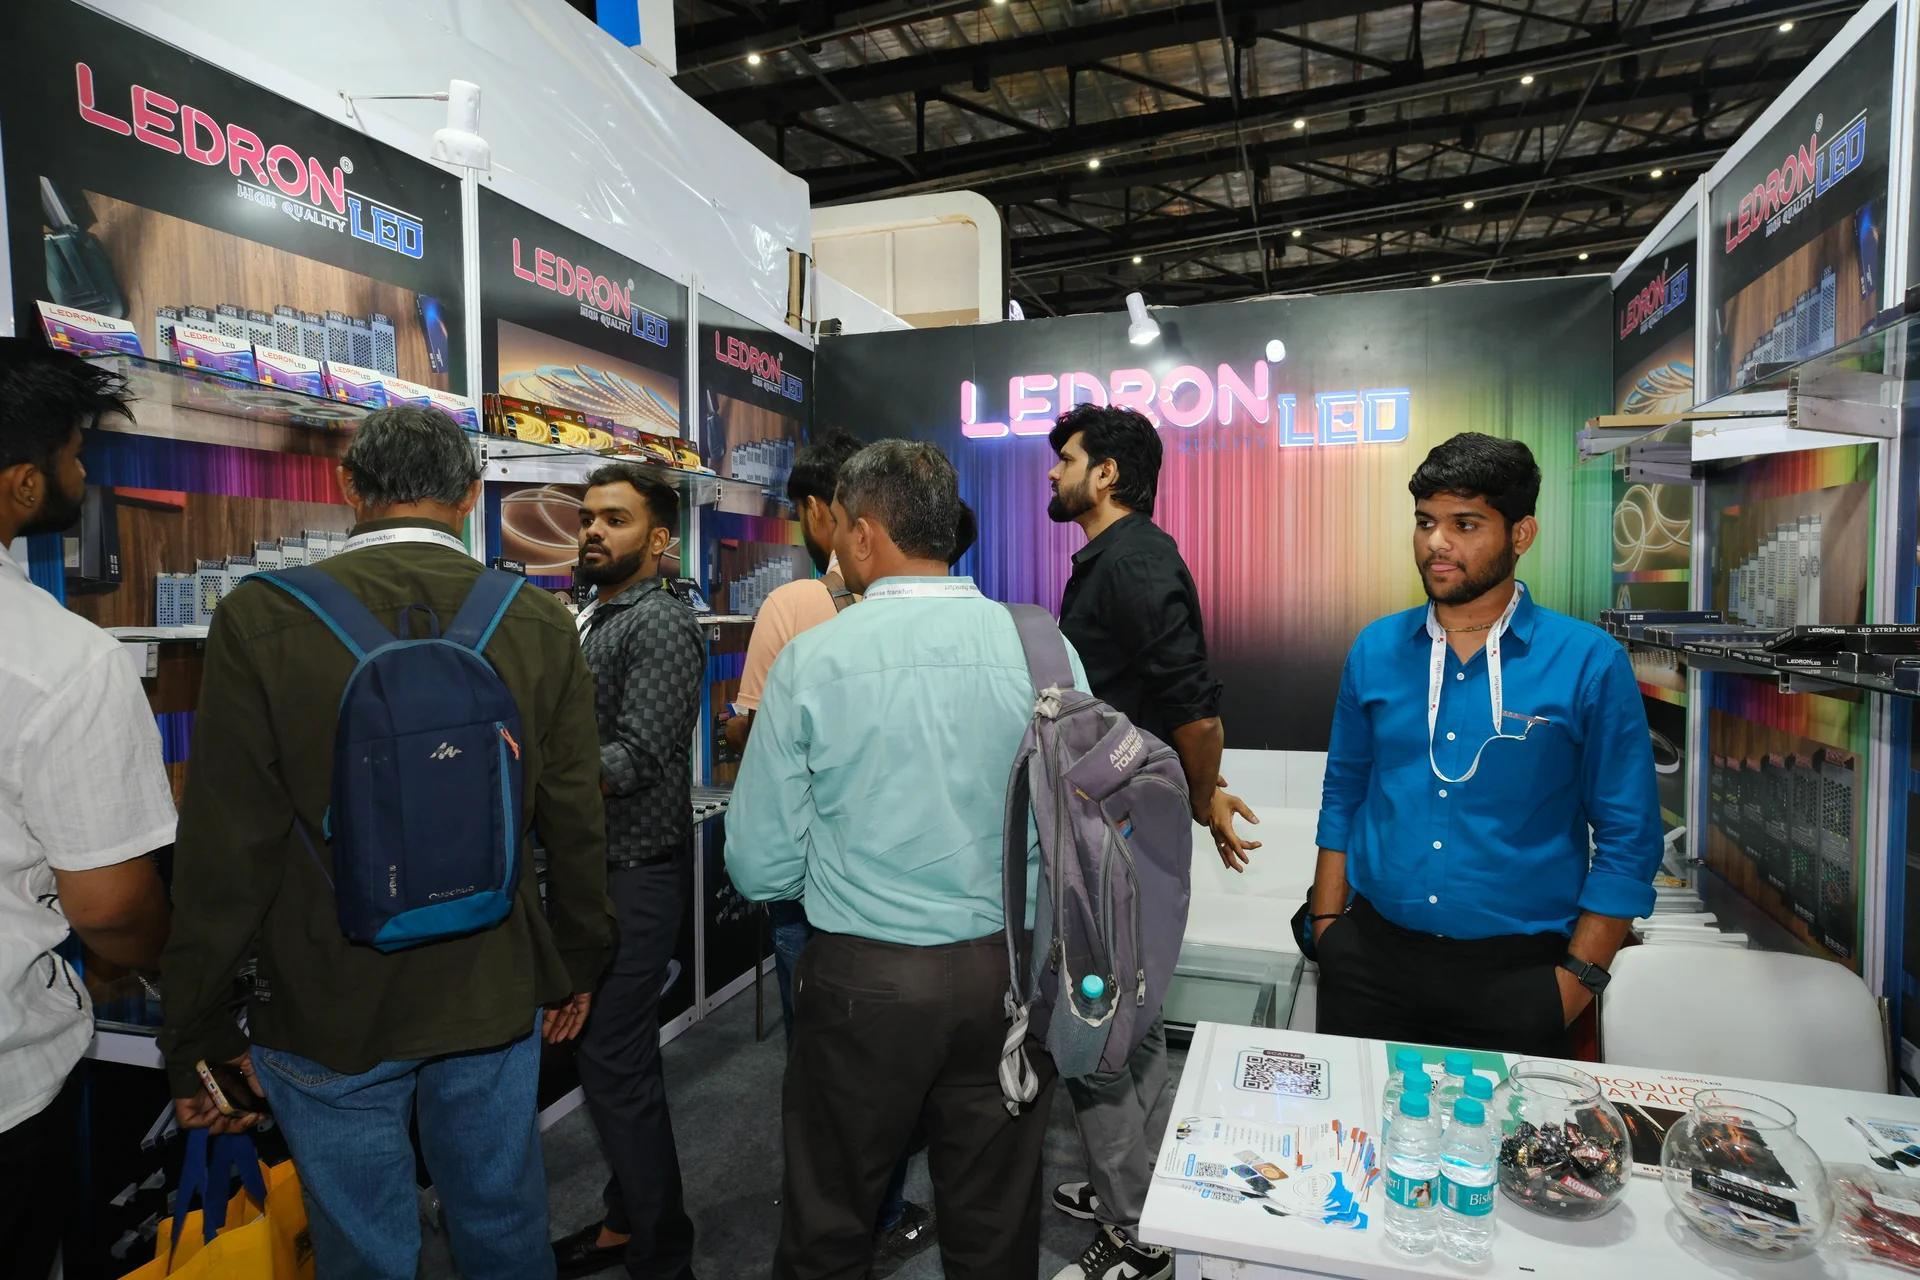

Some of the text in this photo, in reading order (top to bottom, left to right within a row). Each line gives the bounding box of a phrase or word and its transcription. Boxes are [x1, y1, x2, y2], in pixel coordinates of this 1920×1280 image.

[75, 61, 424, 260] LEDRON LED
[1725, 116, 1867, 254] LEDRON LED
[237, 183, 347, 233] HIGH QUALITY
[512, 236, 669, 348] LEDRON LED
[1620, 268, 1689, 340] LEDRON LED
[48, 307, 116, 330] LEDRON LED
[580, 305, 631, 333] HIGH QUALITY
[183, 331, 236, 350] LEDRON LED
[262, 350, 294, 363] LEDRON
[294, 362, 307, 370] LED
[333, 365, 360, 377] LEDRON
[715, 329, 803, 403] LEDRON LED
[959, 358, 1411, 449] LEDRON LED
[365, 533, 396, 543] frankfurt
[1594, 1076, 1716, 1097] RODUC
[1566, 1176, 1603, 1200] KOPIKO
